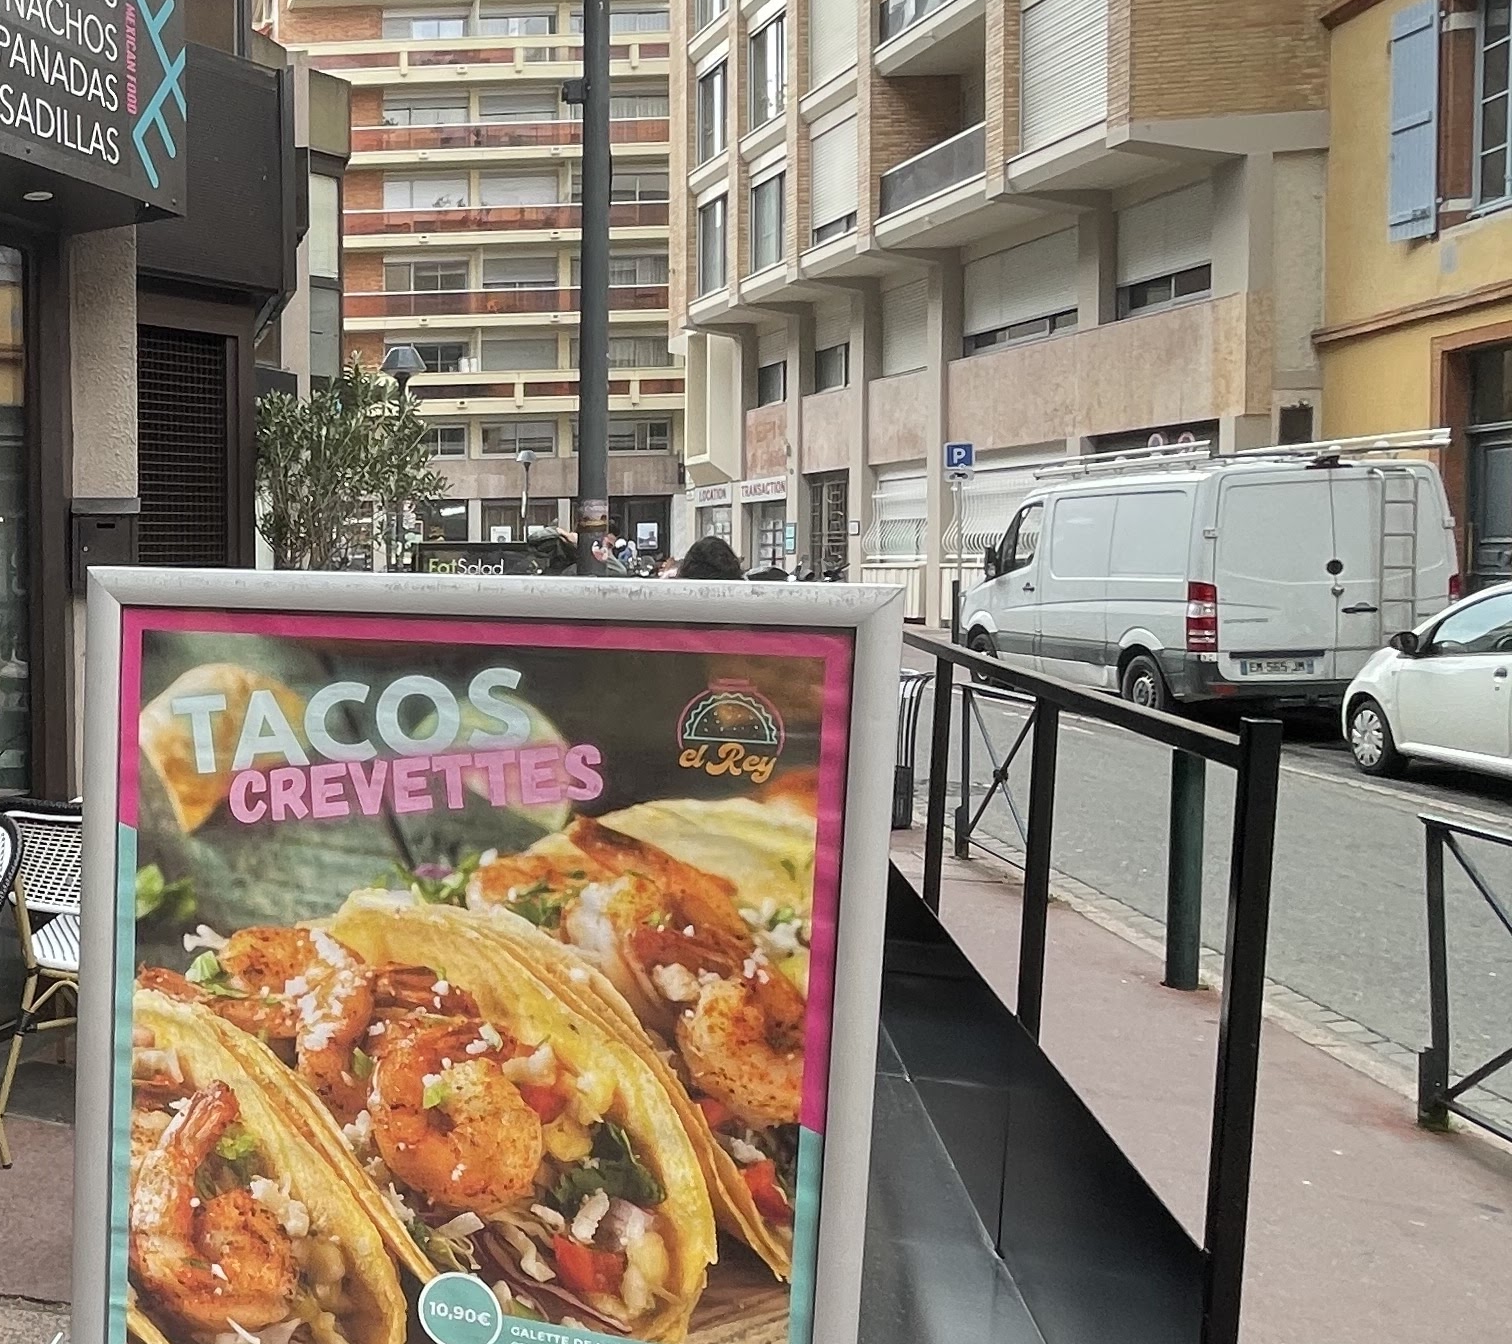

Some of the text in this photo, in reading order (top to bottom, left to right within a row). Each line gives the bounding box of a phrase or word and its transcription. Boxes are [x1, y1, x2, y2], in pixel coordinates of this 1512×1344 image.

[125, 2, 138, 115] MEXICAN FOOD
[953, 447, 966, 464] P
[698, 488, 726, 502] LOCATION
[741, 481, 786, 497] TRANSACTION
[171, 667, 531, 774] TACOS
[679, 742, 778, 784] el Rey
[229, 744, 604, 824] CREVETTES
[429, 1301, 492, 1327] 10,90€
